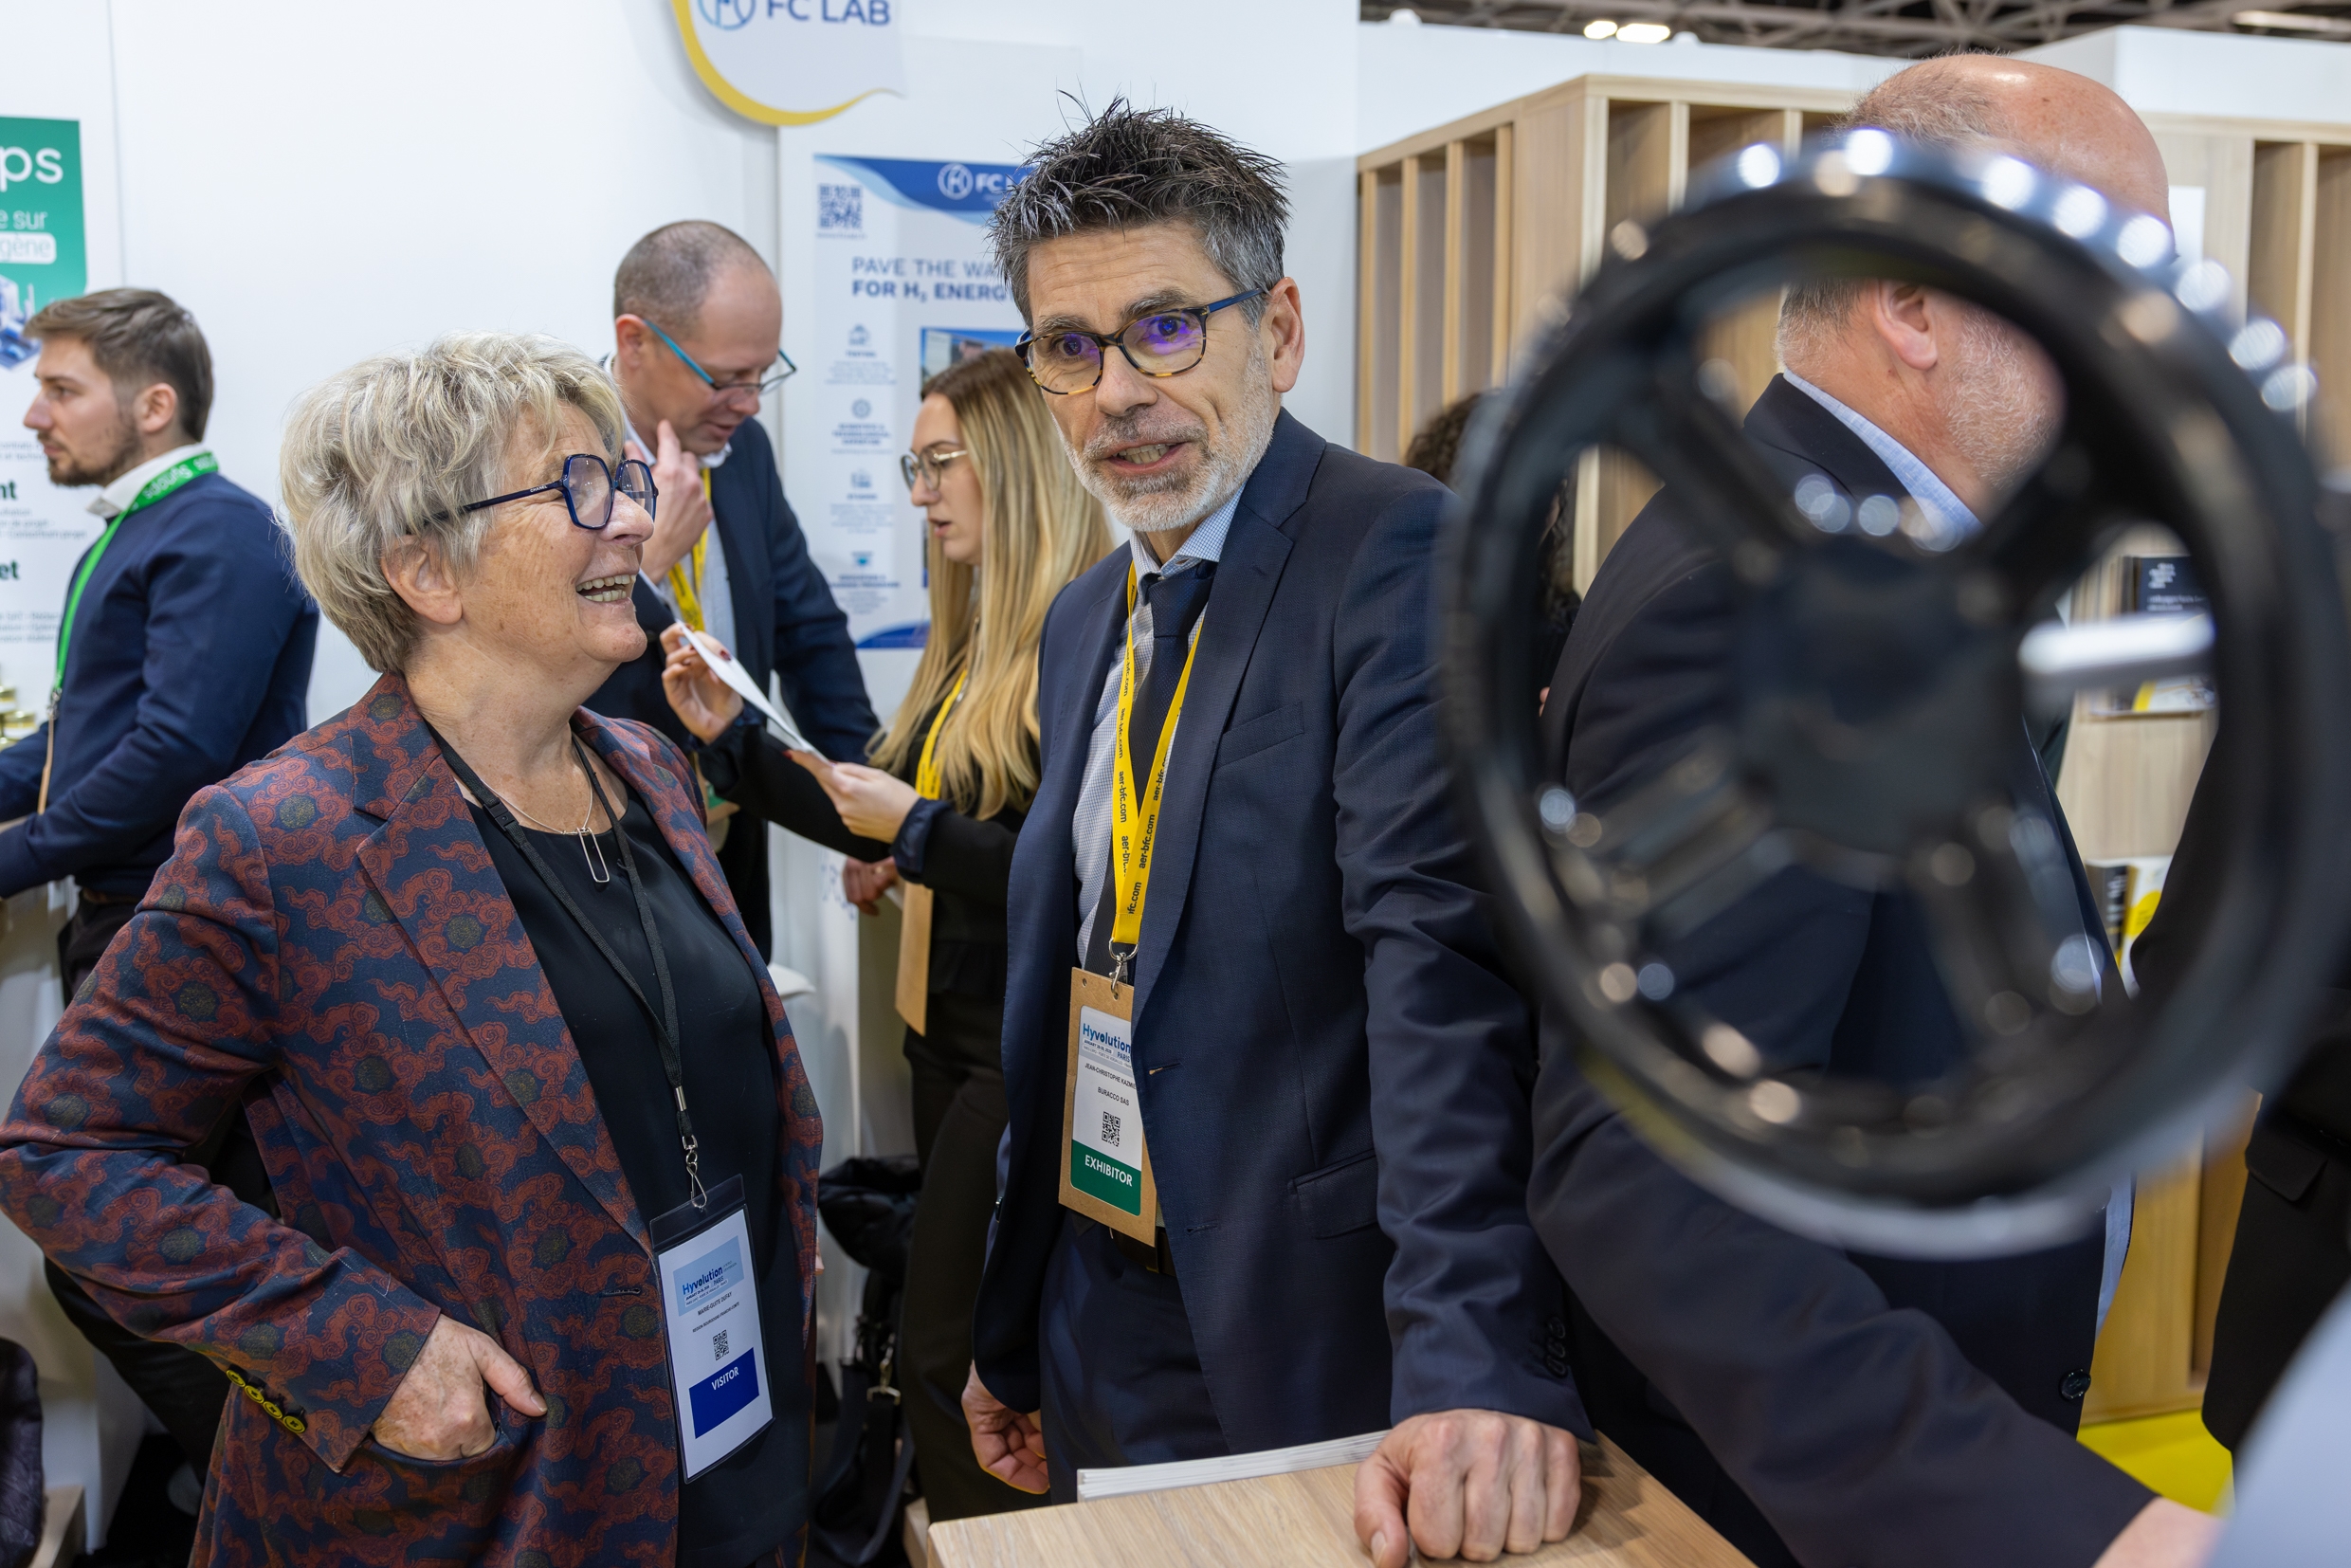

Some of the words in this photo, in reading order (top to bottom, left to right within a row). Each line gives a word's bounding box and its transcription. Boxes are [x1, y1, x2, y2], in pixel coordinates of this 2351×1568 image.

[822, 0, 890, 26] LAB
[0, 146, 64, 192] ps
[12, 210, 48, 230] sur
[852, 256, 907, 276] PAVE
[913, 259, 957, 277] THE
[852, 280, 896, 297] FOR
[530, 484, 548, 493] CHANEL
[1119, 771, 1127, 823] aer-bfc.com
[1139, 814, 1155, 869] aer-bfc.com
[1083, 1023, 1131, 1054] Hyvolution
[1084, 1063, 1121, 1083] JEAN-CHRISTOPHE
[1098, 1086, 1120, 1102] BURACCO
[1120, 1097, 1130, 1106] SAS
[1084, 1154, 1133, 1188] EXHIBITOR
[682, 1267, 723, 1296] Hyvolution
[711, 1366, 739, 1391] VISITOR
